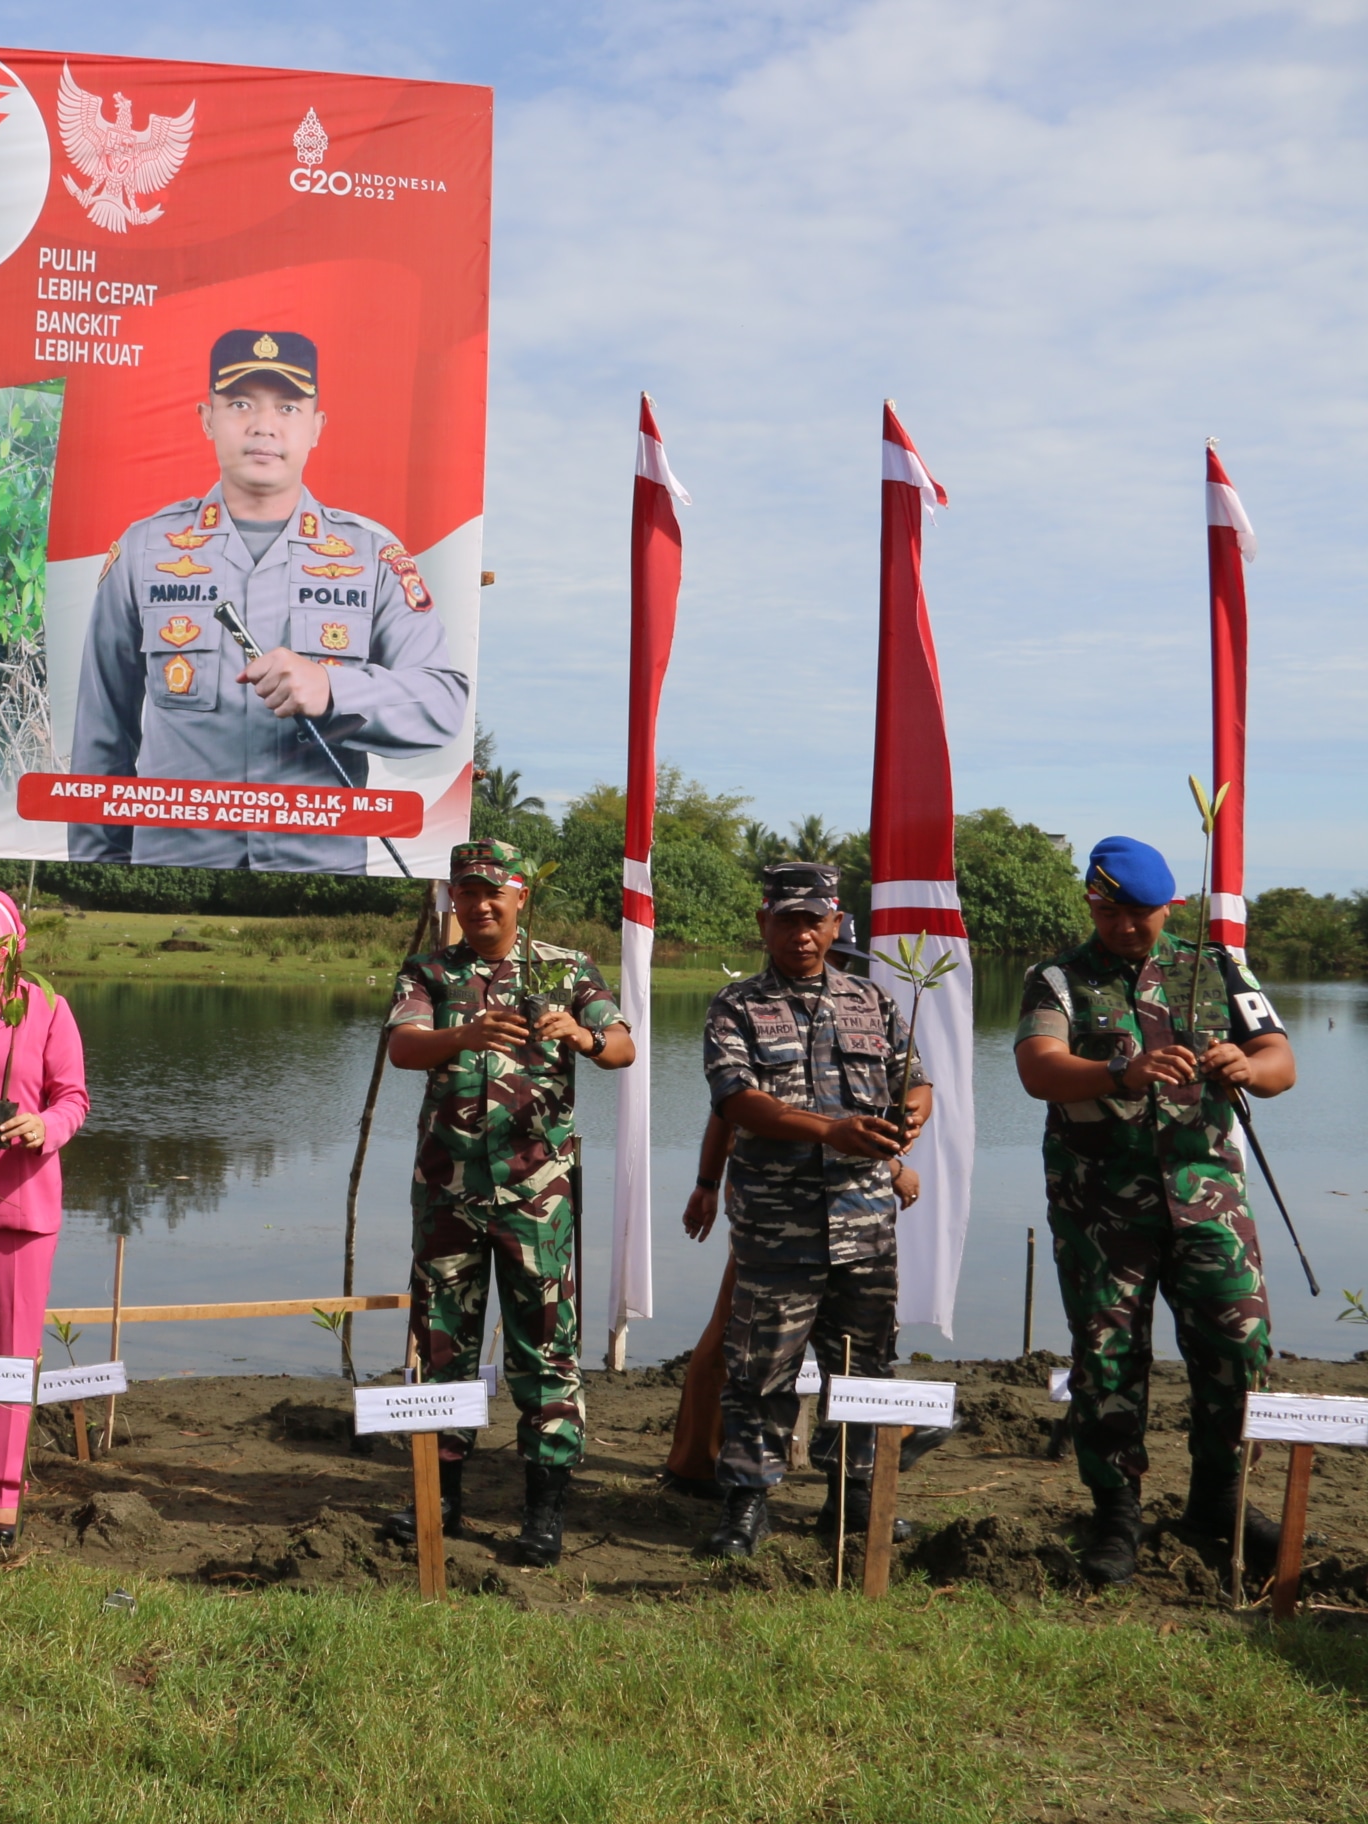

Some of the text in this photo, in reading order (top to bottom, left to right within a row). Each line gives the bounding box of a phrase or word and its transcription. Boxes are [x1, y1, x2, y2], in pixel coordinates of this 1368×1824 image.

[289, 167, 351, 196] G20
[354, 172, 447, 193] INDONESIA
[354, 187, 395, 200] 2022
[38, 248, 96, 273] PULIH
[37, 277, 158, 307] LEBIH CEPAT
[36, 310, 121, 337] BANGKIT
[34, 338, 143, 367] LEBIH KUAT
[150, 585, 218, 603] PANDJI.S
[300, 588, 367, 607] POLRI
[51, 782, 393, 812] AKBP PANDJI SANTOSO, S.I.K, M.Si
[103, 803, 340, 827] KAPOLRES ACEH BARAT
[841, 1017, 864, 1028] TNI
[42, 1374, 111, 1390] BHAYANGKARI
[390, 1408, 453, 1419] ACEH BARAT
[918, 1400, 950, 1410] BARAT
